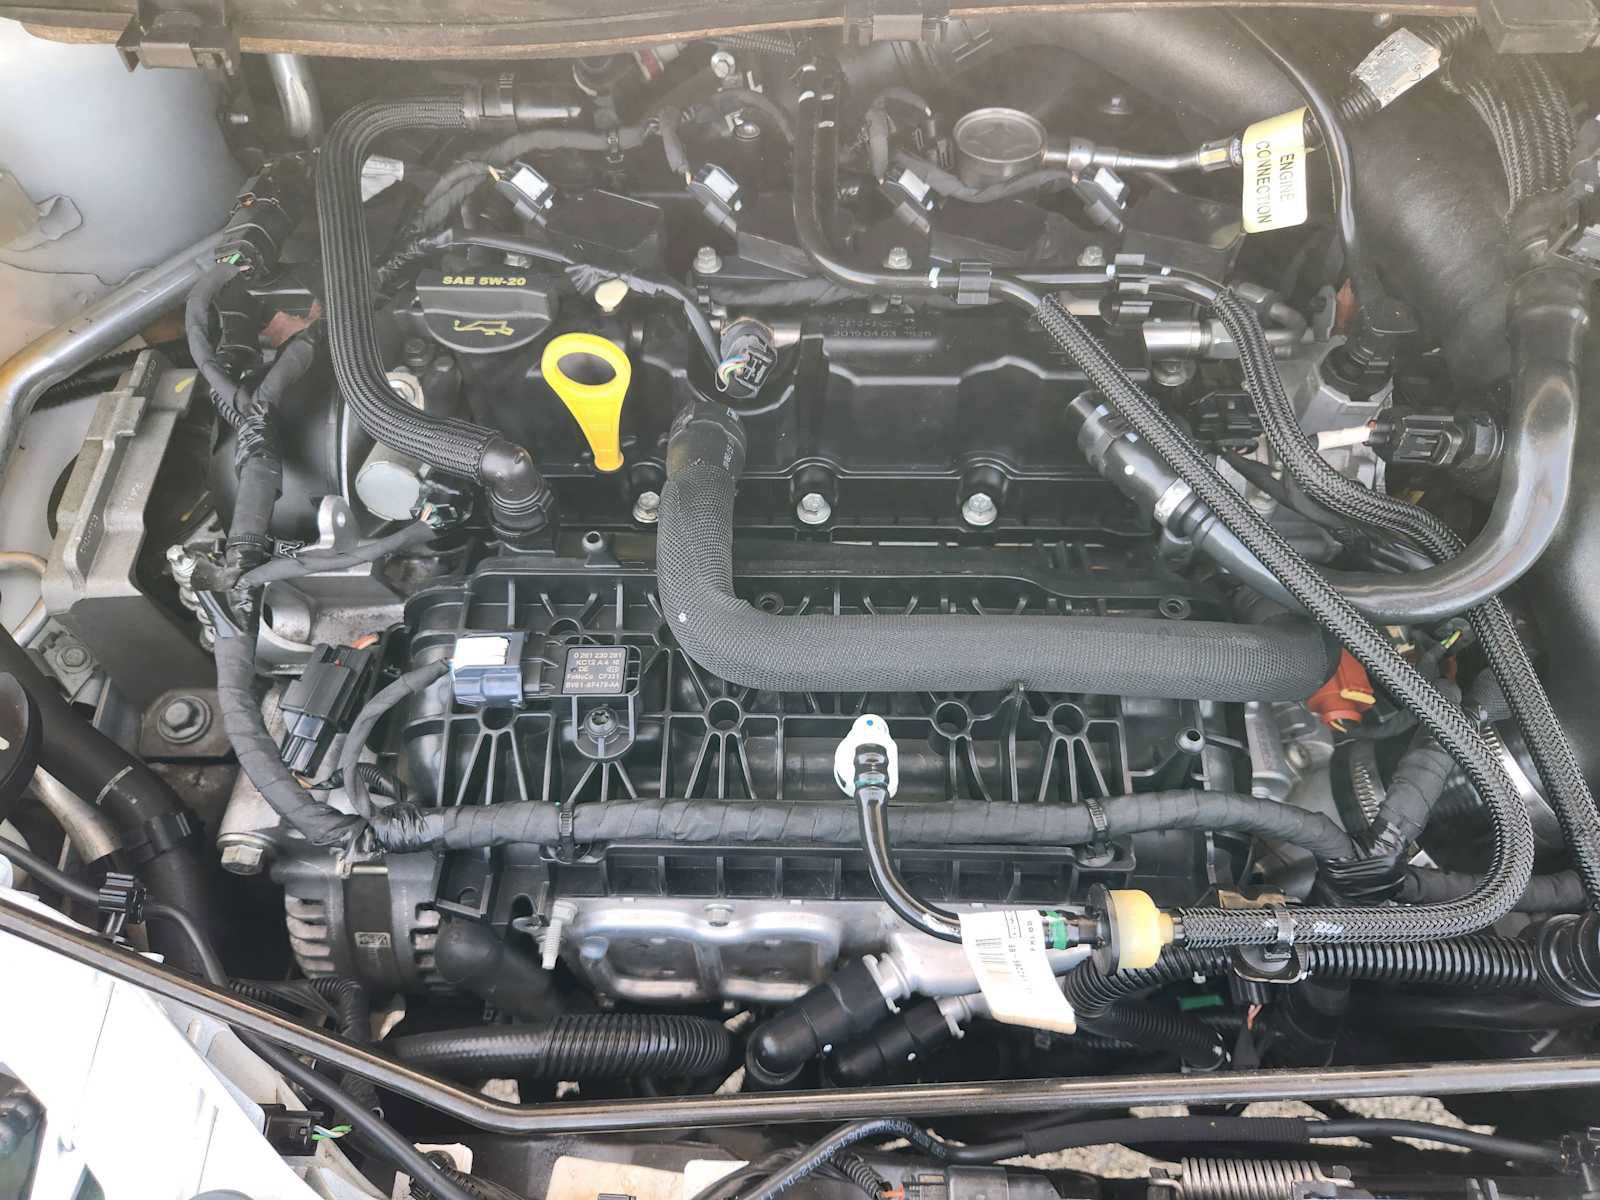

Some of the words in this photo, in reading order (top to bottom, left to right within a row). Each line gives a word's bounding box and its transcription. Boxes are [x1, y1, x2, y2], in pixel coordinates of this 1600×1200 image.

[1256, 140, 1272, 224] CONNECTION
[1280, 153, 1295, 202] ENGINE
[442, 276, 475, 286] SAE
[479, 276, 527, 287] 5W-20
